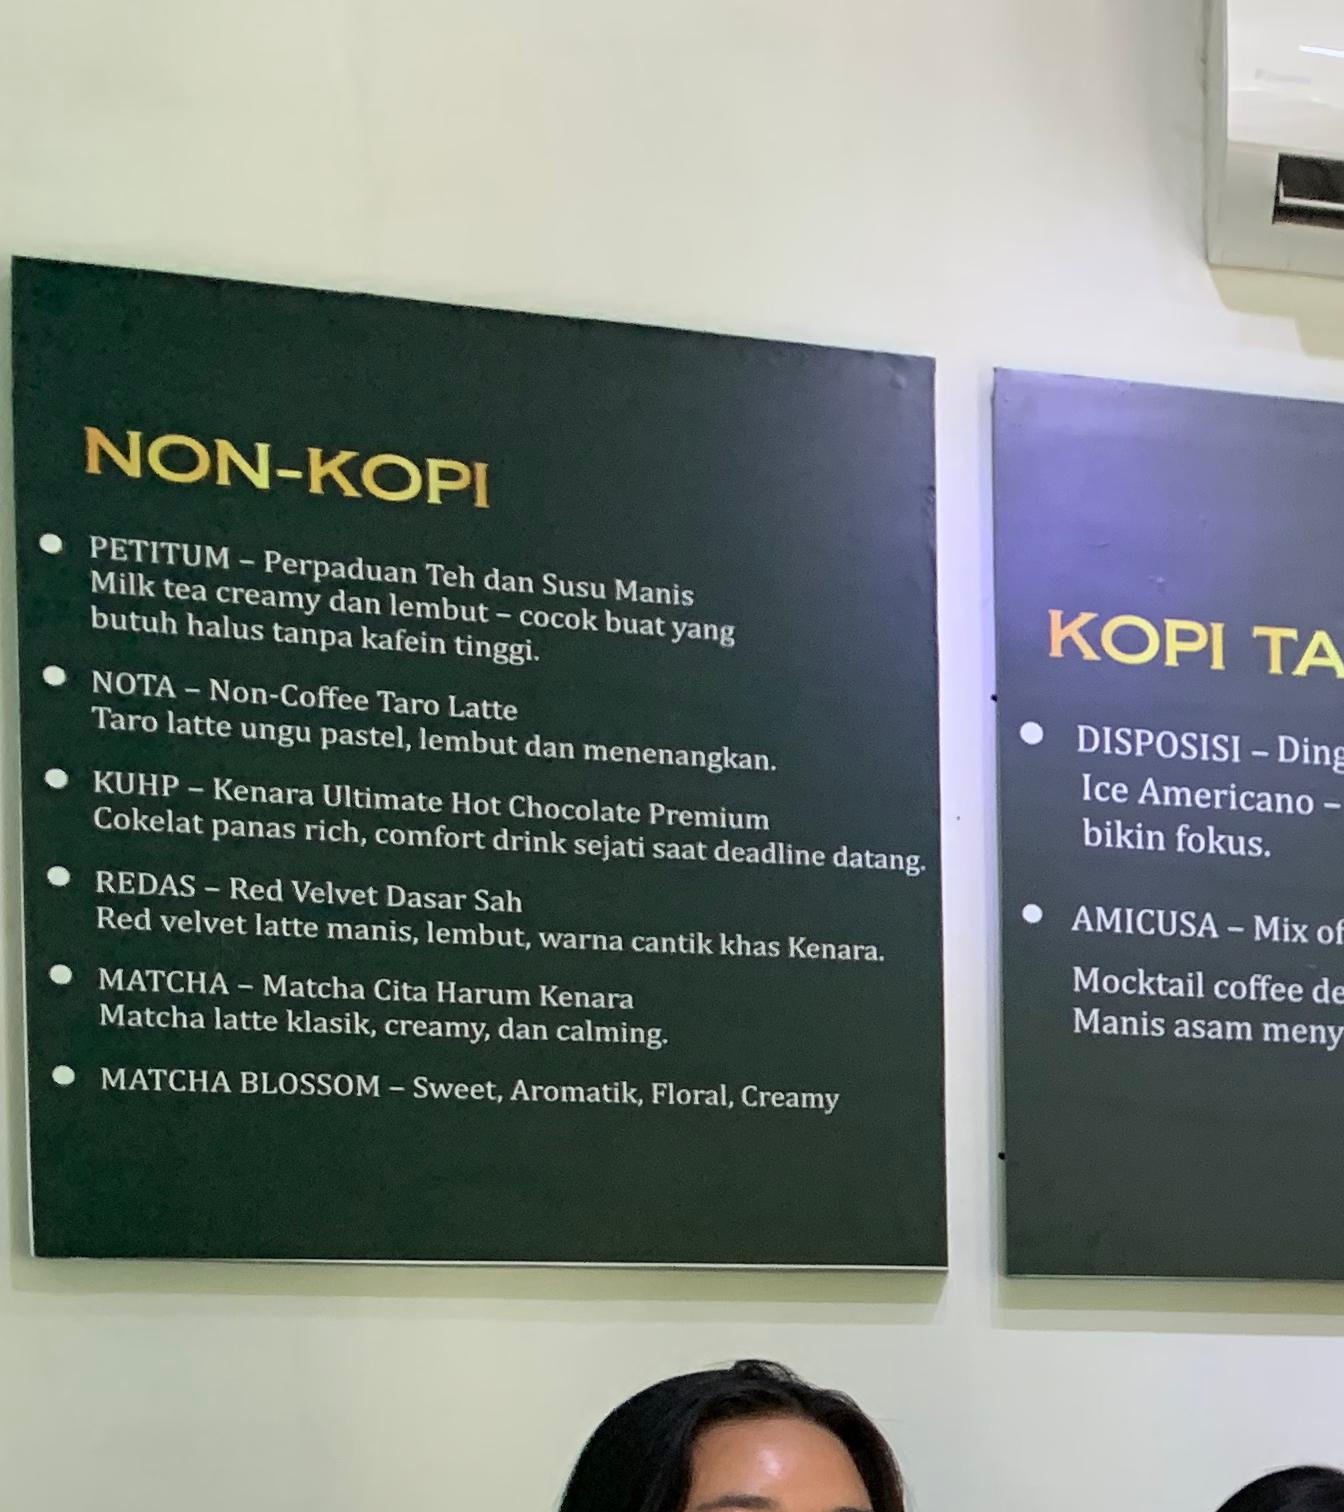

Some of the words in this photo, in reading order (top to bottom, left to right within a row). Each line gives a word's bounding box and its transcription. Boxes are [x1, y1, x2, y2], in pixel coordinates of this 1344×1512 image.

[84, 426, 490, 508] NON-KOPI
[89, 535, 230, 570] PETITUM
[263, 550, 418, 585] Perpaduan
[425, 562, 476, 589] Teh
[483, 567, 535, 594] dan
[542, 572, 607, 600] Susu
[614, 578, 695, 607] Manis
[90, 569, 156, 598] Milk
[163, 578, 208, 602] tea
[216, 586, 322, 616] creamy
[329, 588, 381, 616] dan
[389, 592, 490, 624] lembut
[519, 607, 599, 632] cocok
[604, 608, 666, 637] buat
[671, 620, 736, 648] yang
[90, 604, 179, 635] butuh
[186, 612, 264, 641] halus
[272, 622, 353, 652] tanpa
[360, 625, 447, 655] kafein
[453, 634, 540, 666] tinggi.
[1048, 608, 1226, 671] KOPI
[92, 669, 177, 699] NOTA
[209, 678, 369, 712] Non-Coffee
[375, 689, 440, 716] Taro
[448, 694, 519, 722] Latte
[90, 705, 158, 733] Taro
[167, 710, 233, 738] latte
[240, 722, 311, 748] ungu
[319, 725, 412, 752] pastel,
[419, 726, 518, 756] lembut
[524, 733, 575, 760] dan
[583, 743, 777, 774] menenangkan.
[1078, 725, 1240, 763] DISPOSISI
[93, 770, 180, 798] KUHP
[213, 777, 315, 807] Kenara
[323, 783, 443, 813] Ultimate
[451, 791, 502, 817] Hot
[508, 794, 641, 824] Chocolate
[648, 802, 770, 831] Premium
[1083, 774, 1128, 803] Ice
[1138, 778, 1313, 815] Americano
[1083, 818, 1165, 851] bikin
[1176, 824, 1270, 857] fokus.
[95, 870, 196, 898] REDAS
[229, 876, 284, 903] Red
[291, 879, 379, 907] Velvet
[386, 884, 467, 911] Dasar
[473, 888, 523, 913] Sah
[1071, 906, 1219, 938] AMICUSA
[1255, 915, 1308, 943] Mix
[98, 967, 230, 995] MATCHA
[262, 974, 366, 1000] Matcha
[373, 978, 428, 1003] Cita
[436, 980, 532, 1006] Harum
[538, 984, 634, 1010] Kenara
[1073, 967, 1204, 998] Mocktail
[1214, 974, 1303, 1002] coffee
[1074, 1008, 1164, 1036] Manis
[1174, 1019, 1252, 1040] asam
[100, 1066, 232, 1094] MATCHA
[240, 1071, 381, 1098] BLOSSOM
[413, 1076, 503, 1104] Sweet,
[509, 1078, 643, 1108] Aromatik,
[651, 1082, 734, 1110] Floral,
[741, 1084, 841, 1115] Creamy
